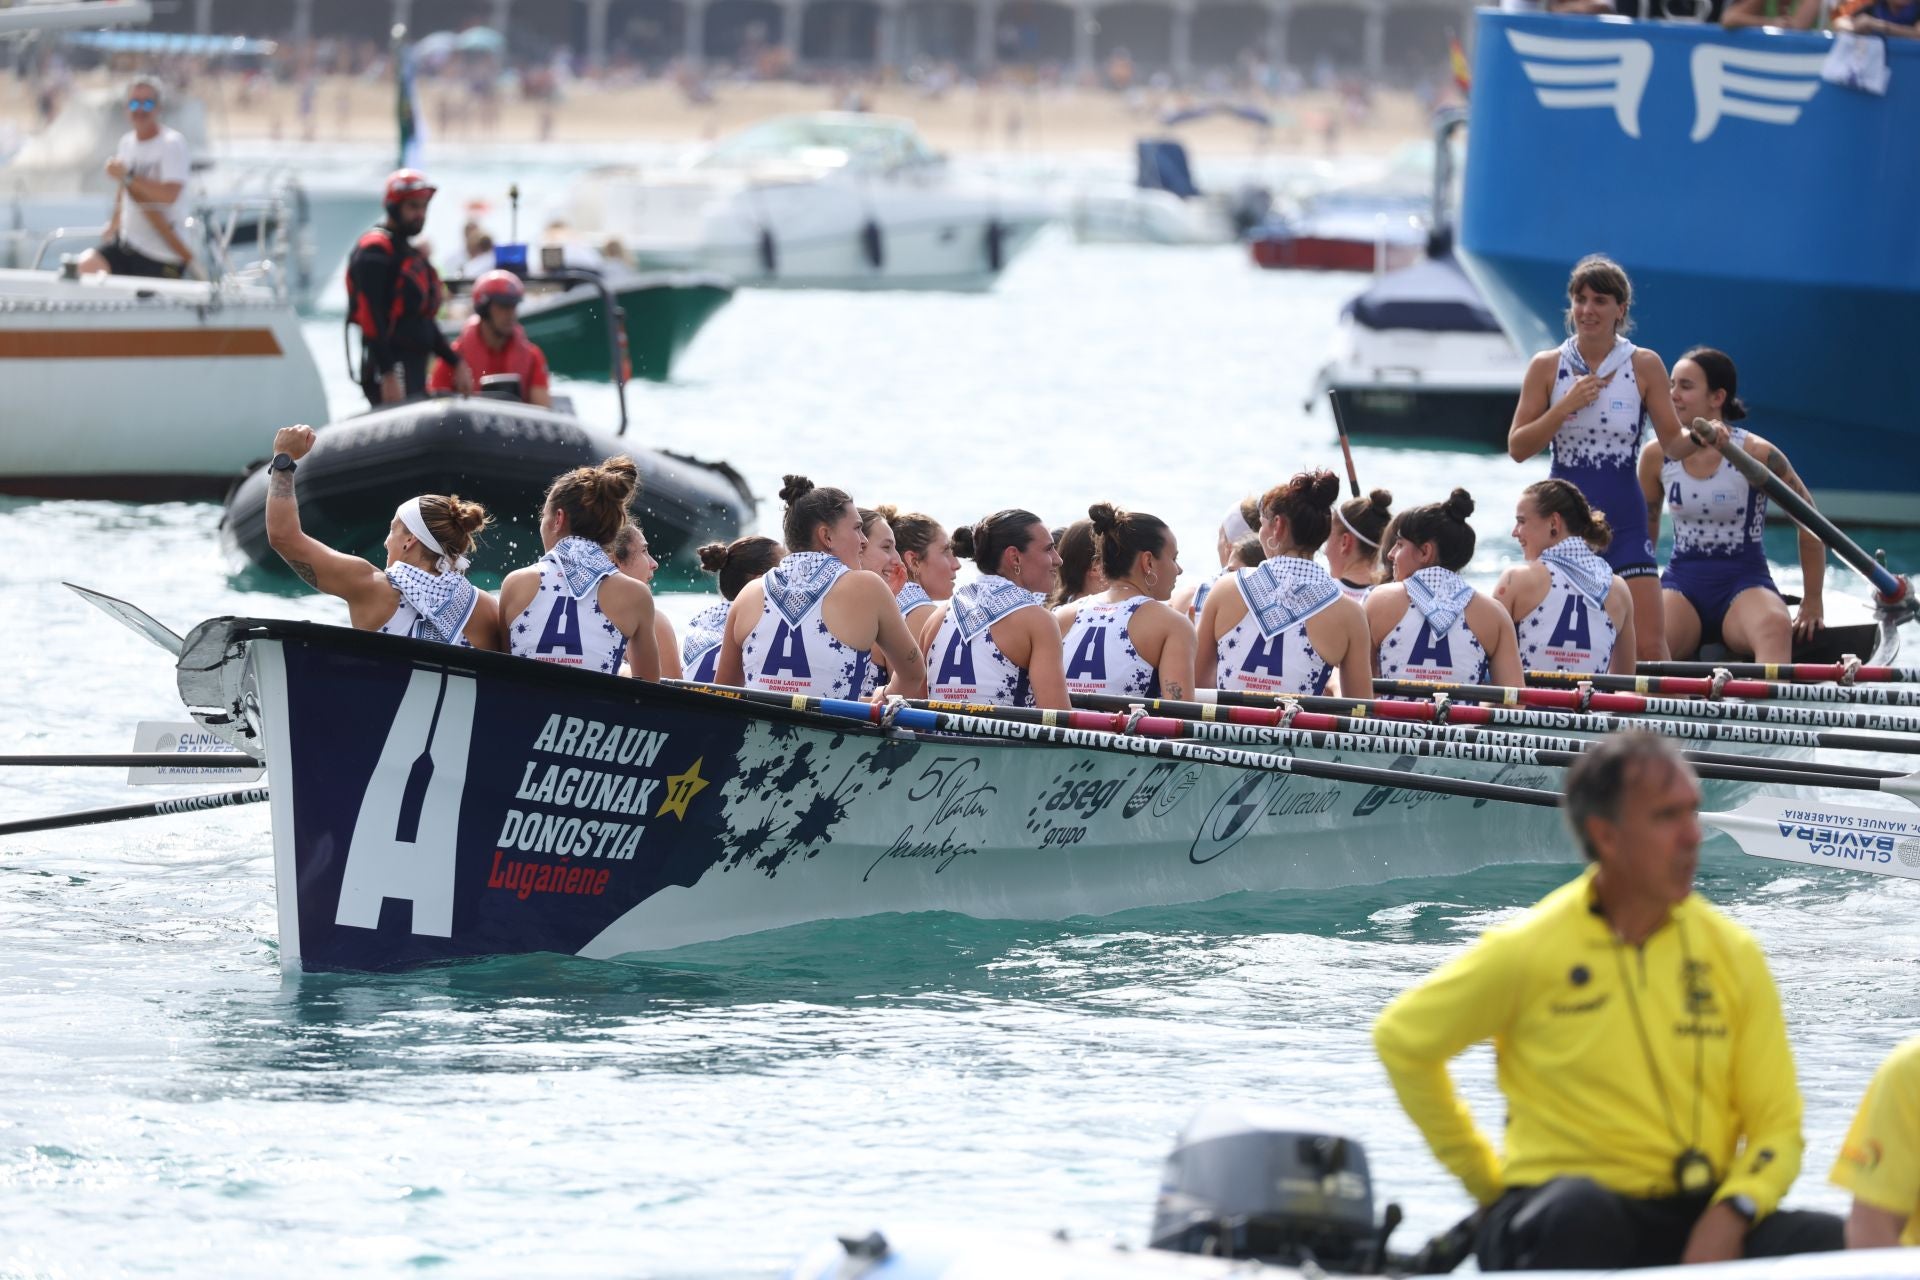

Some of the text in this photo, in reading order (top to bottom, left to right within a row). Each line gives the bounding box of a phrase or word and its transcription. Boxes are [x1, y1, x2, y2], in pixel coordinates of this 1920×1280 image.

[1066, 626, 1107, 680] A
[964, 702, 996, 714] sport
[1777, 684, 1889, 705] DONOSTIA
[1493, 708, 1609, 732] DONOSTIA
[1716, 724, 1821, 746] LAGUNAK
[1645, 697, 1758, 722] DONOSTIA
[1766, 705, 1857, 728] ARRAUN
[533, 713, 670, 768] ARRAUN
[944, 714, 1056, 742] LAGUNAK
[1063, 729, 1162, 754] ARRAUN
[1349, 717, 1467, 743] DONOSTIA
[1475, 730, 1571, 752] ARRAUN
[1172, 742, 1293, 771] DONOSTIA
[1193, 722, 1539, 765] DONOSTIA ARRAUN LAGUNAK
[155, 792, 235, 815] DONOSTIA
[335, 662, 478, 939] A
[515, 761, 660, 816] LAGUNAK
[670, 779, 694, 804] 11
[1045, 767, 1137, 819] asegi
[1267, 786, 1341, 817] Lurauto
[1784, 809, 1853, 826] SALABERRIA
[1857, 817, 1907, 832] MANUEL
[497, 809, 645, 860] DONOSTIA
[1038, 825, 1088, 850] grupo
[1778, 823, 1895, 852] BAVIERA
[1809, 842, 1892, 864] CLINICA
[488, 851, 610, 900] Lugañene
